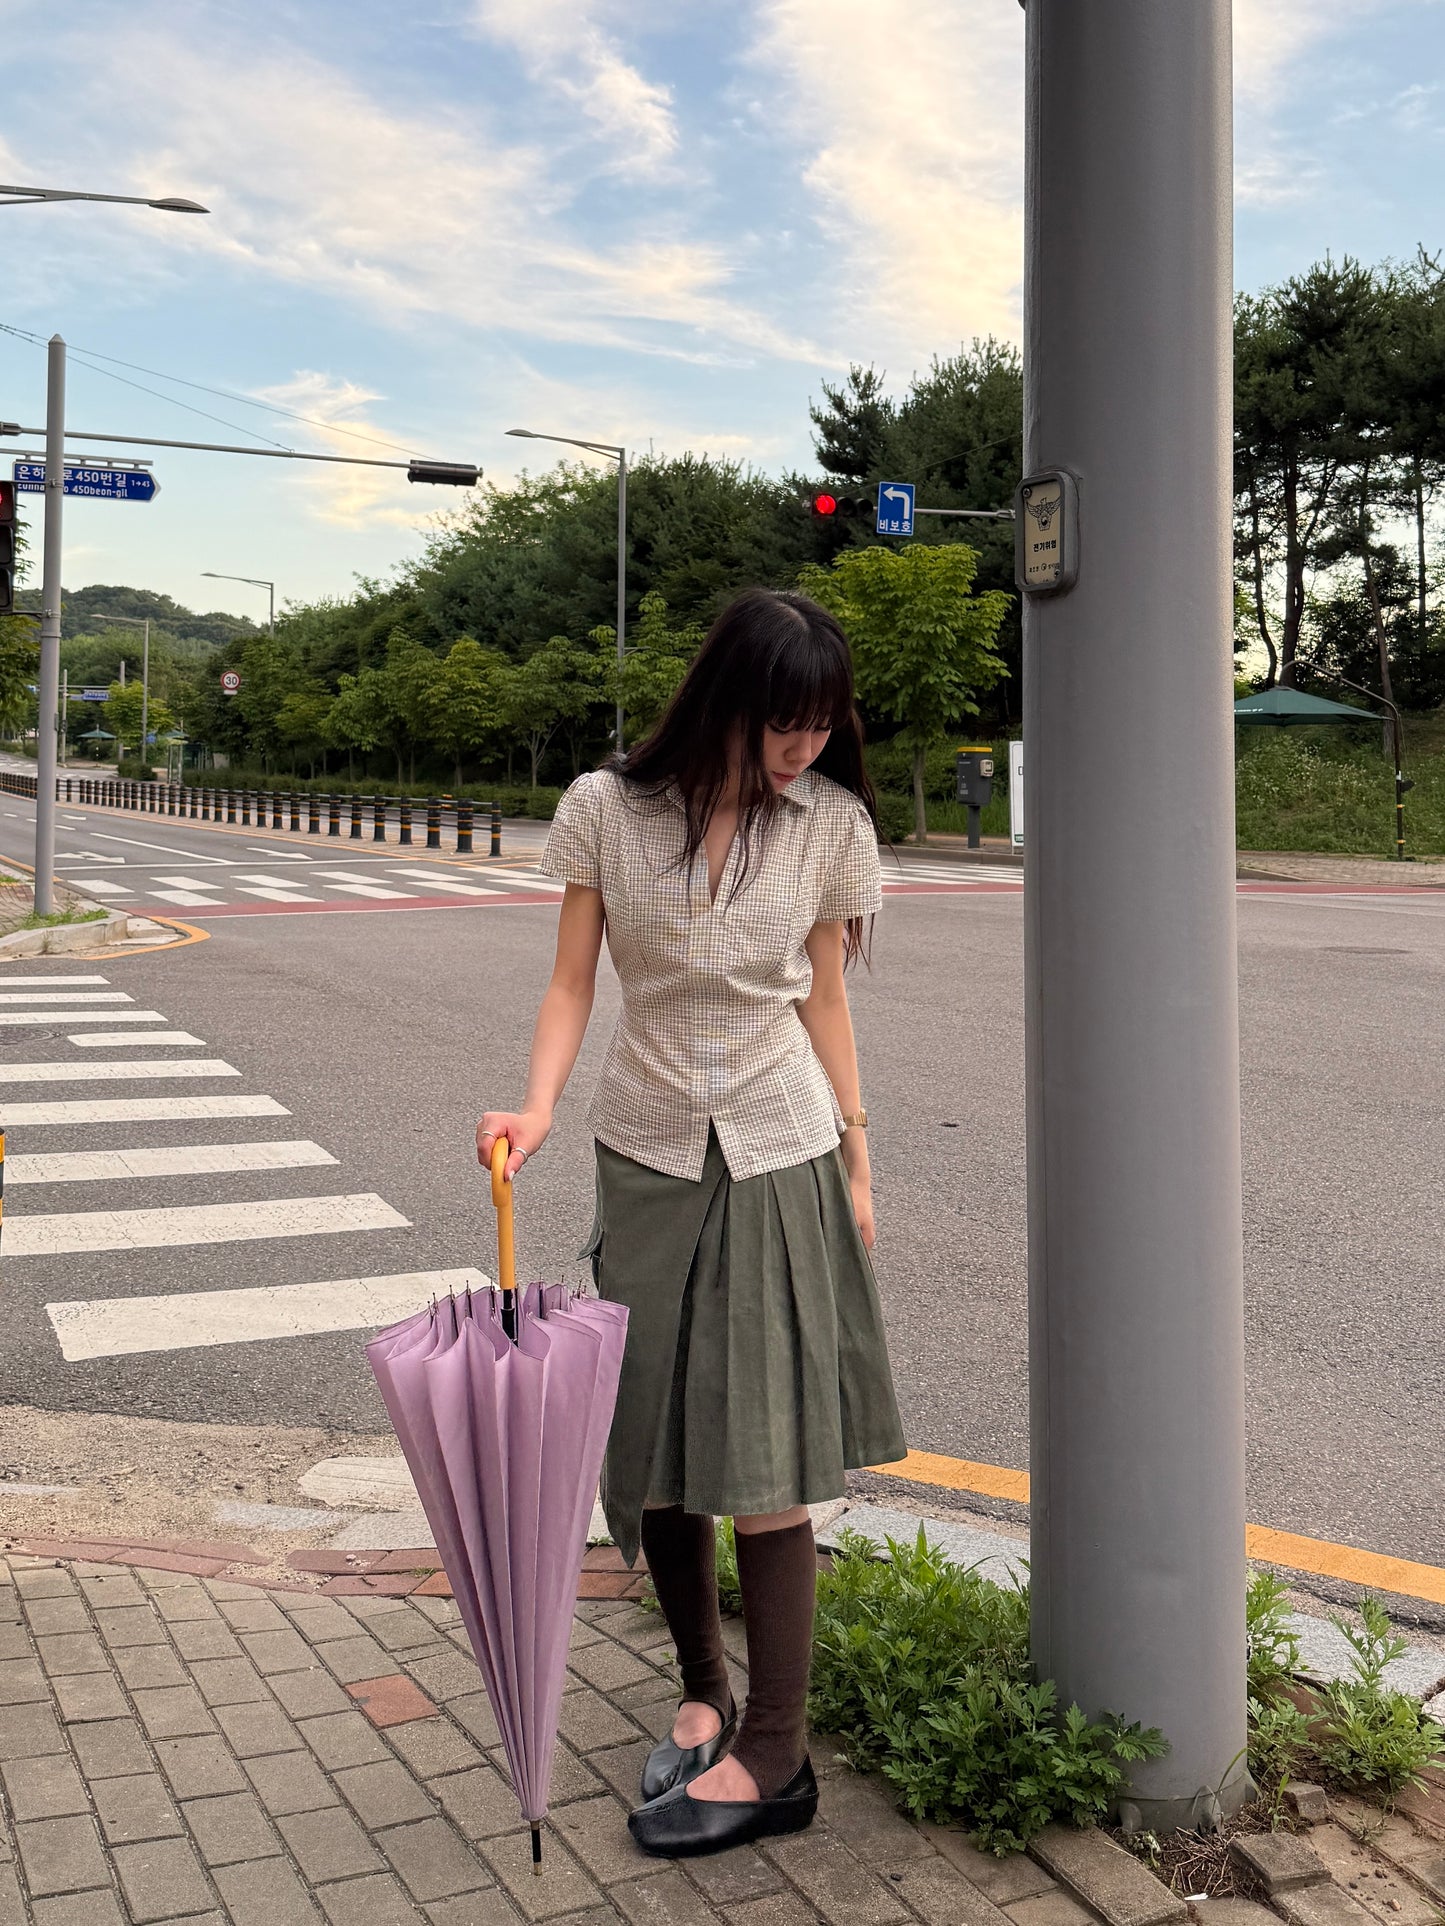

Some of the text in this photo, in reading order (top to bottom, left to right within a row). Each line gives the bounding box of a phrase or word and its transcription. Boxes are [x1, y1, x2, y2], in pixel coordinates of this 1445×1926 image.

[72, 485, 128, 498] 450beon-gil
[879, 519, 911, 532] 비보호
[225, 676, 238, 685] 30
